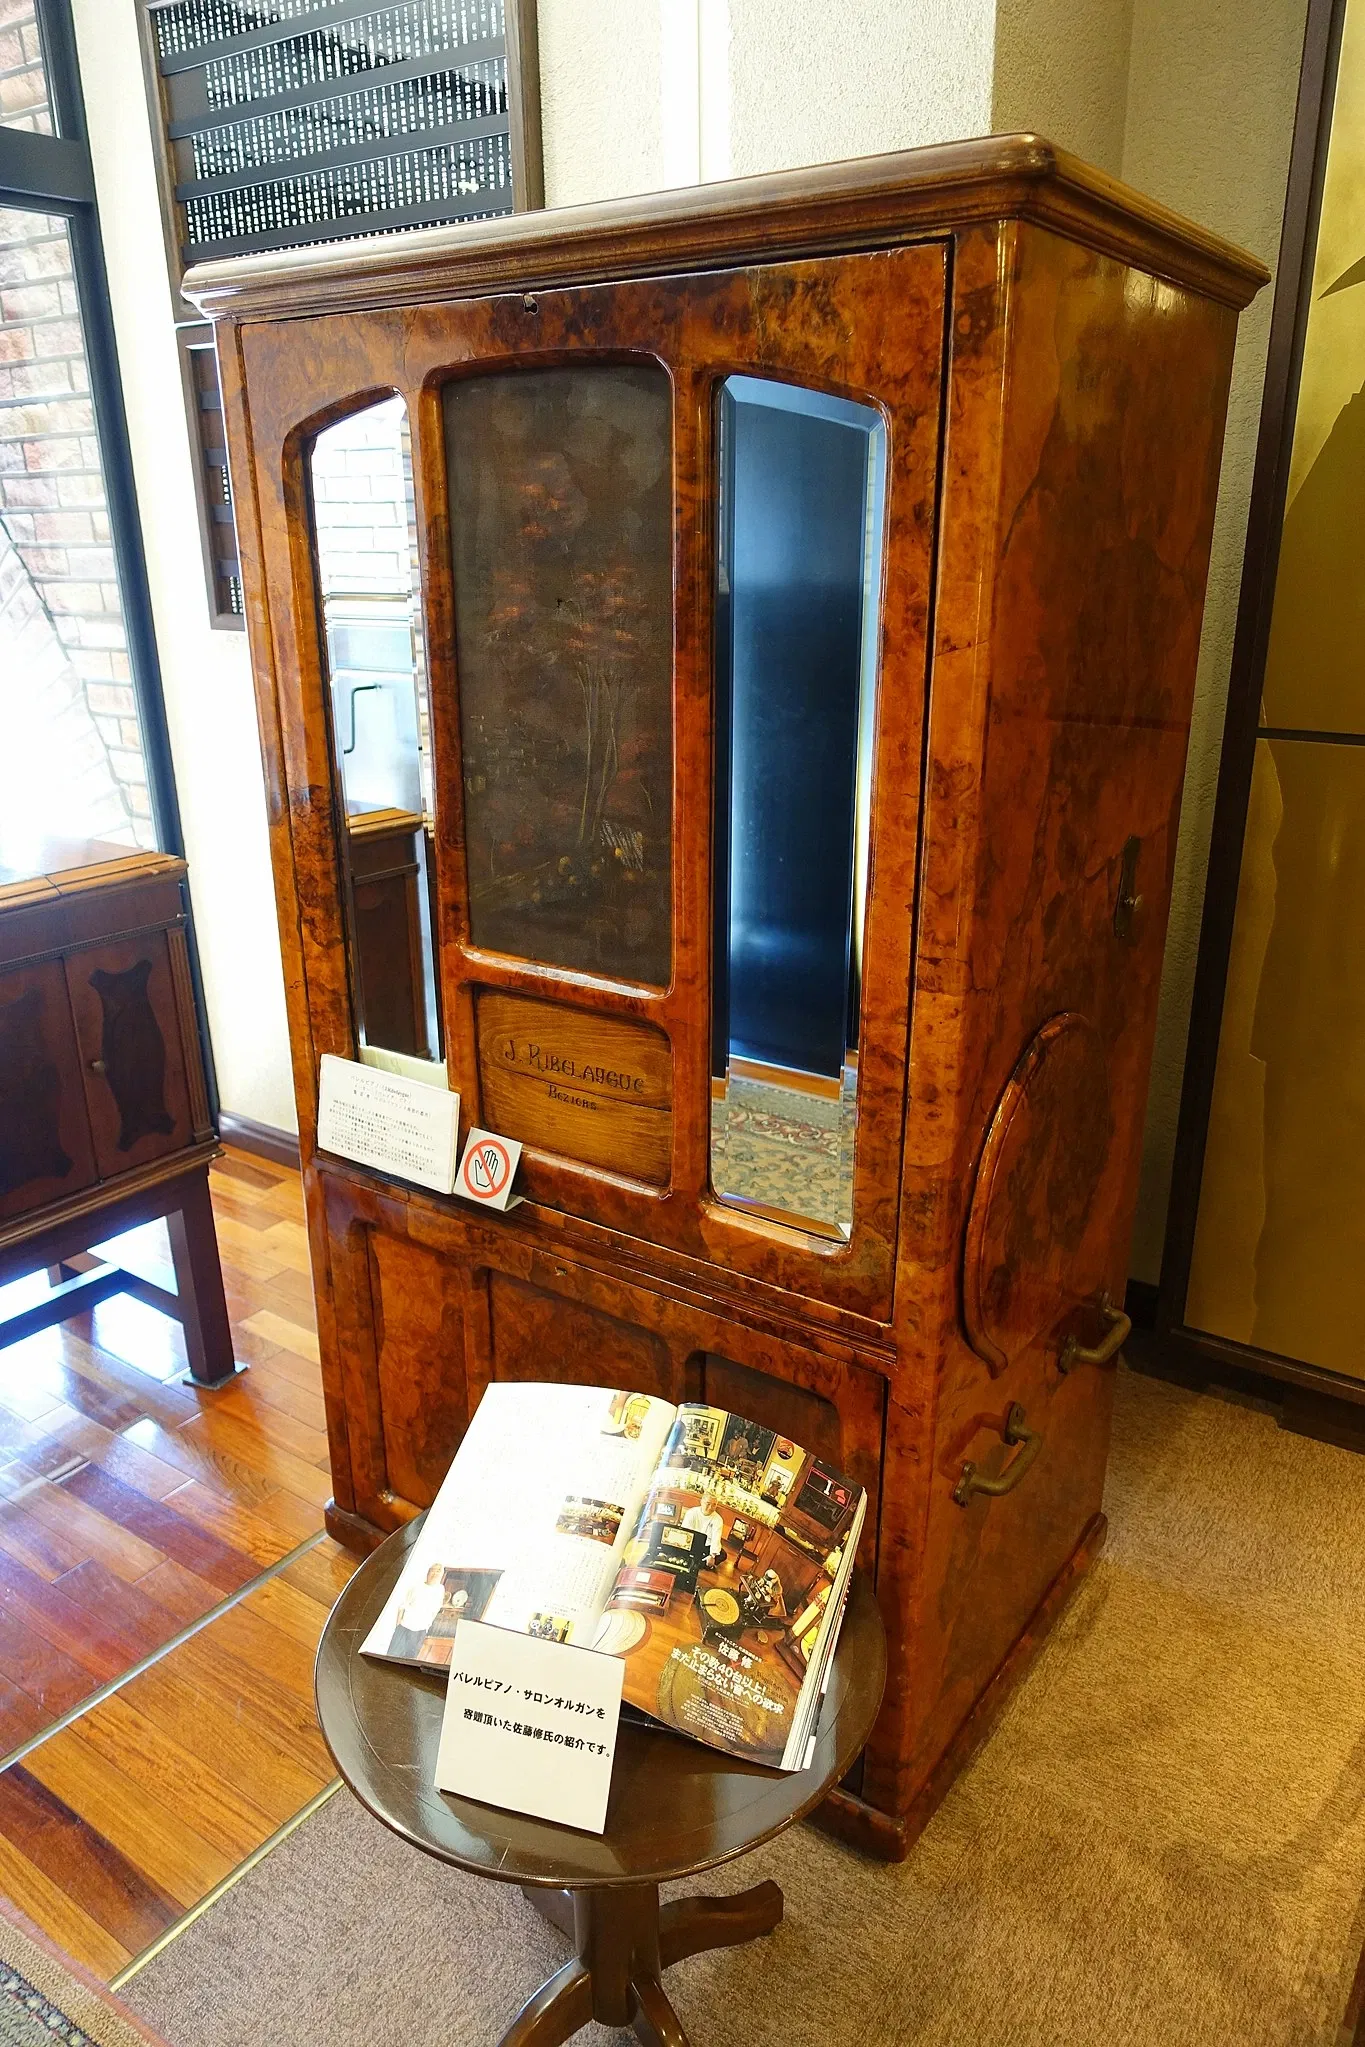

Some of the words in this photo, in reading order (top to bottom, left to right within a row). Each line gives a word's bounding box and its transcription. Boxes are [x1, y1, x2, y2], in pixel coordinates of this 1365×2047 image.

[504, 1039, 523, 1062] J.
[453, 1671, 606, 1720] バレルピアノ・サロンオルガンを
[463, 1708, 611, 1758] 寄贈頂いた佐藤修氏の紹介です。
